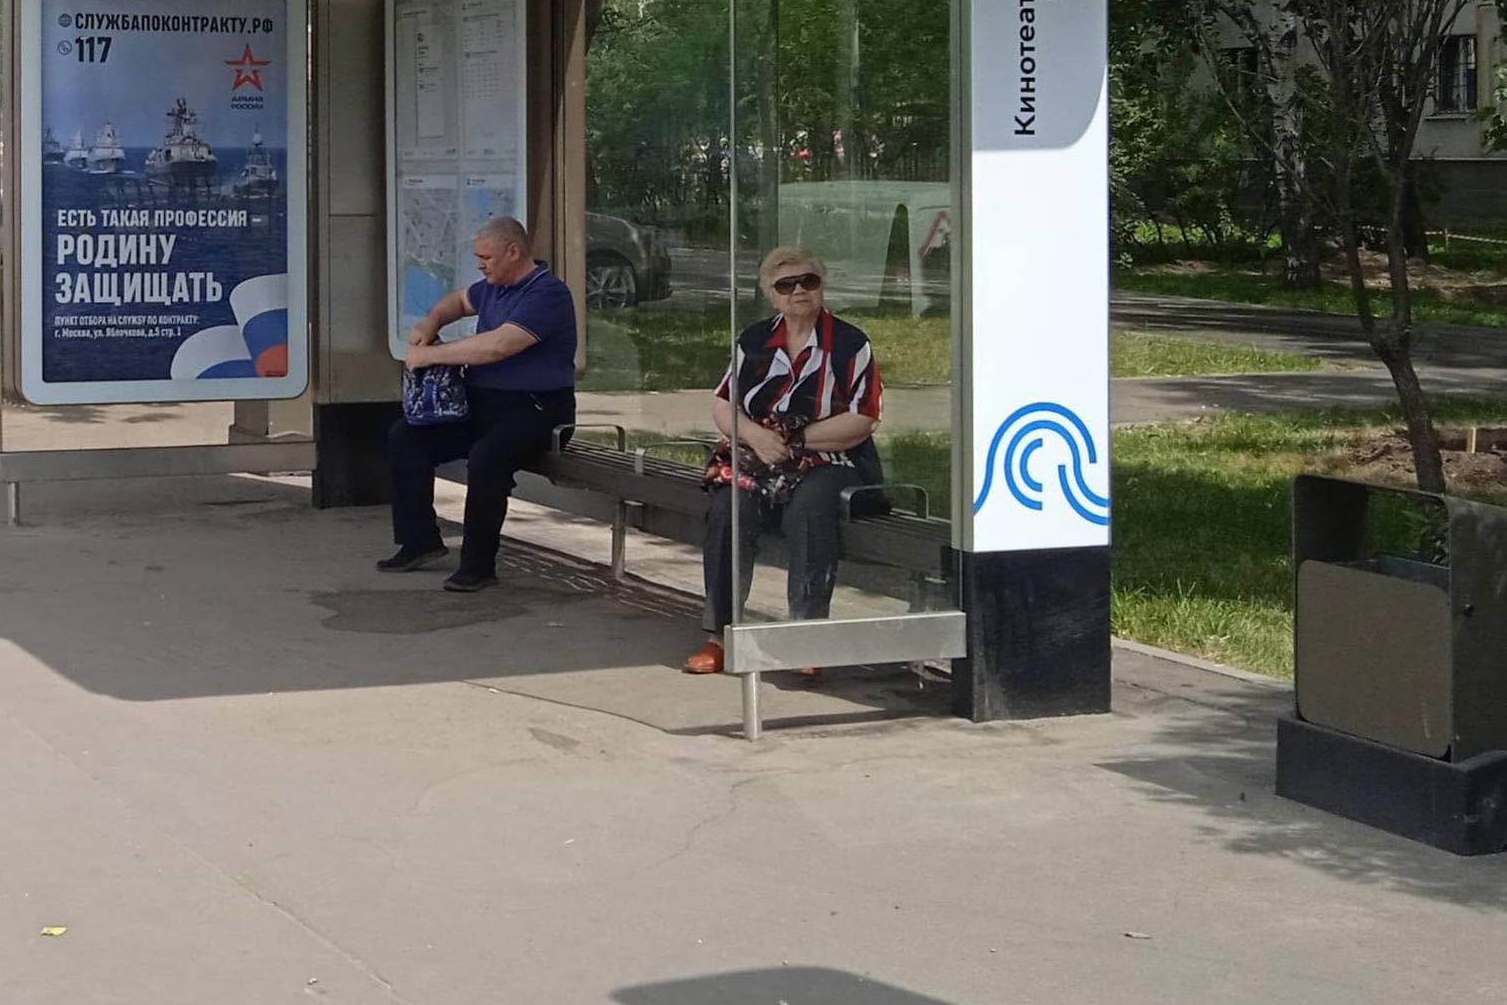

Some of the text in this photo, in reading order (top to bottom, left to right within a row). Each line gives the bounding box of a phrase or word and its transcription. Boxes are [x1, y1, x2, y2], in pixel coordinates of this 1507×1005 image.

[74, 12, 274, 34] СЛУЖБАПОКОНТРАКТУ.РФ
[75, 36, 113, 63] 117
[57, 209, 97, 227] ЕСТЬ
[101, 209, 150, 227] ТАКАЯ
[154, 209, 248, 227] ПРОФЕССИЯ
[56, 233, 177, 268] РОДИНУ
[54, 271, 223, 307] ЗАЩИЩАТЬ
[54, 315, 201, 326] ПУНКТ ОТБОРА НА СЛУЖБУ ПО КОНТРАКТУ:
[54, 329, 61, 338] г.
[61, 327, 93, 338] Москва,
[93, 329, 105, 339] ул.
